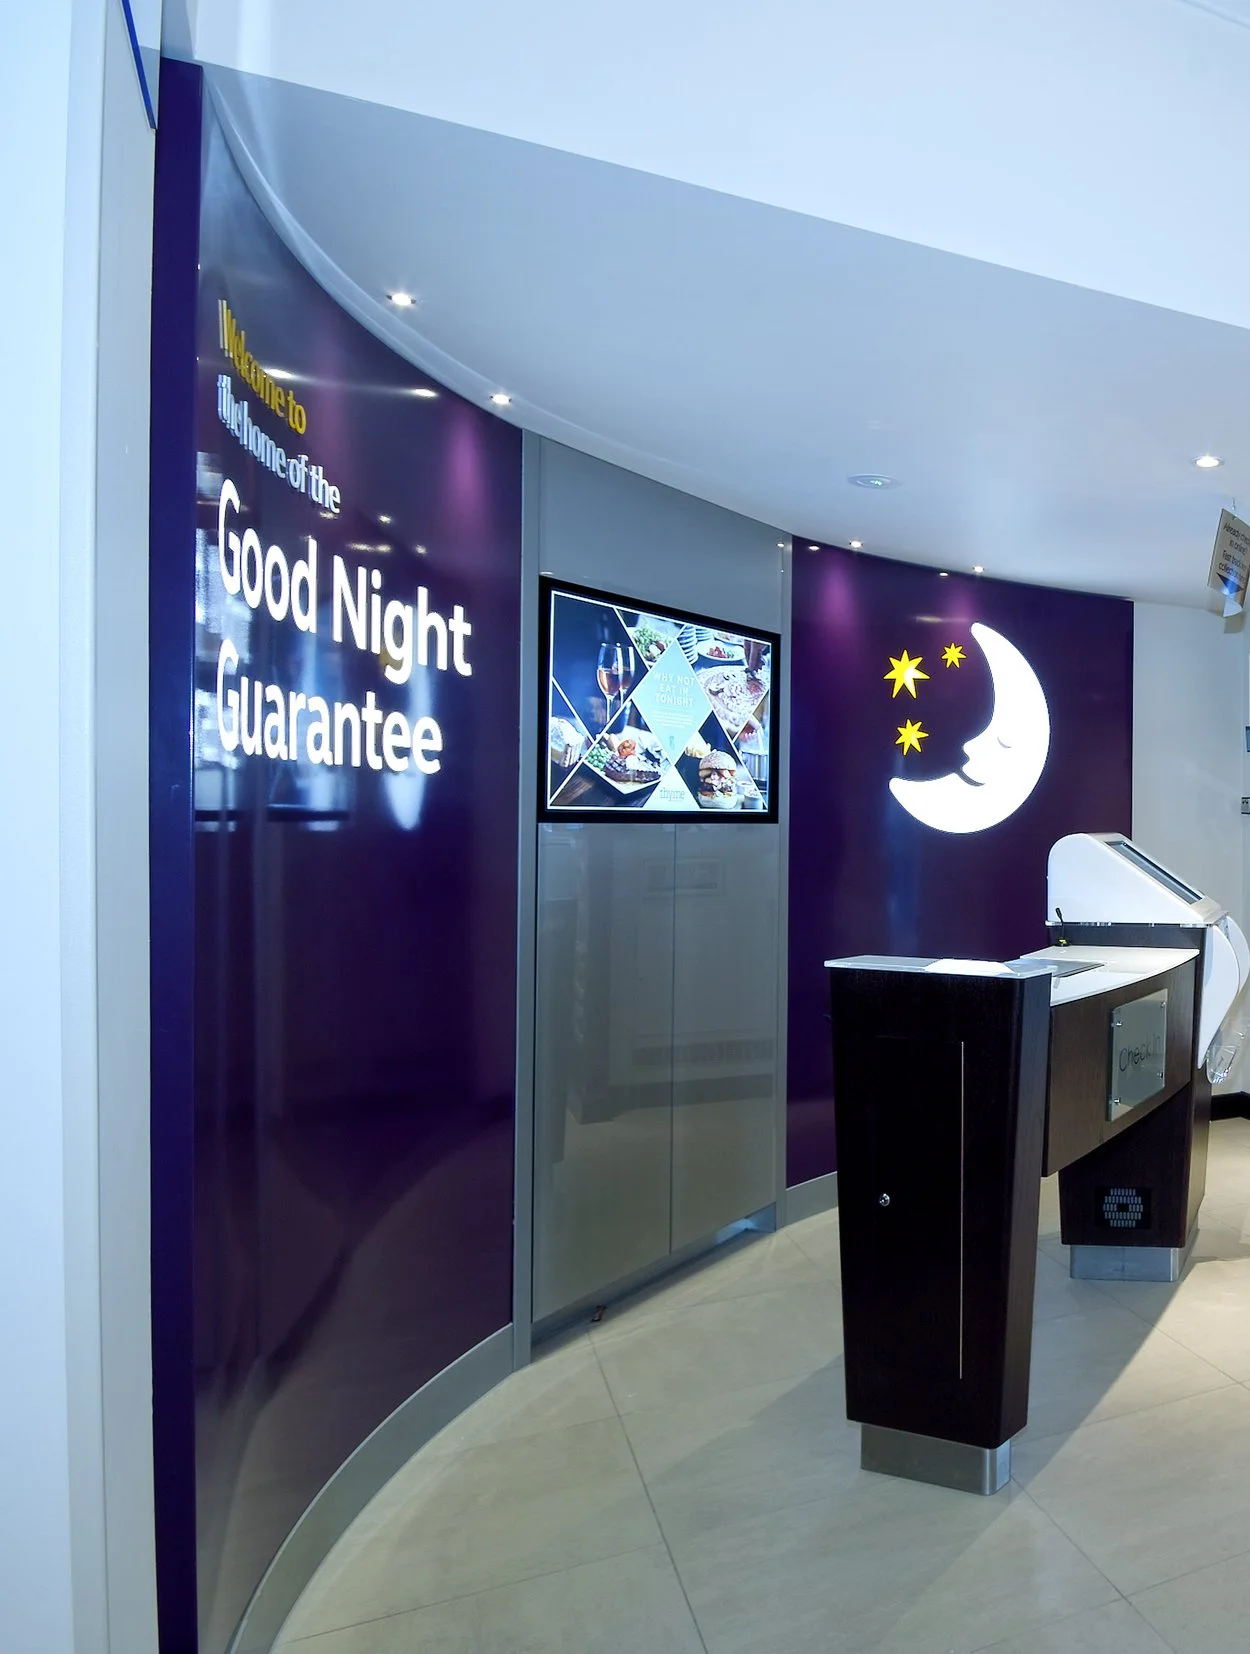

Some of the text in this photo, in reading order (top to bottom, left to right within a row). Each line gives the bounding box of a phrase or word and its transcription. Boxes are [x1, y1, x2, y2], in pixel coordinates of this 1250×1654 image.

[217, 299, 307, 435] Welcome to
[217, 374, 342, 514] the home of the
[217, 478, 473, 685] Good Night
[216, 638, 443, 774] Guarantee
[655, 693, 694, 707] TONIGHT
[659, 684, 689, 695] EAT IN
[677, 675, 695, 686] NOT
[660, 787, 685, 801] thyme
